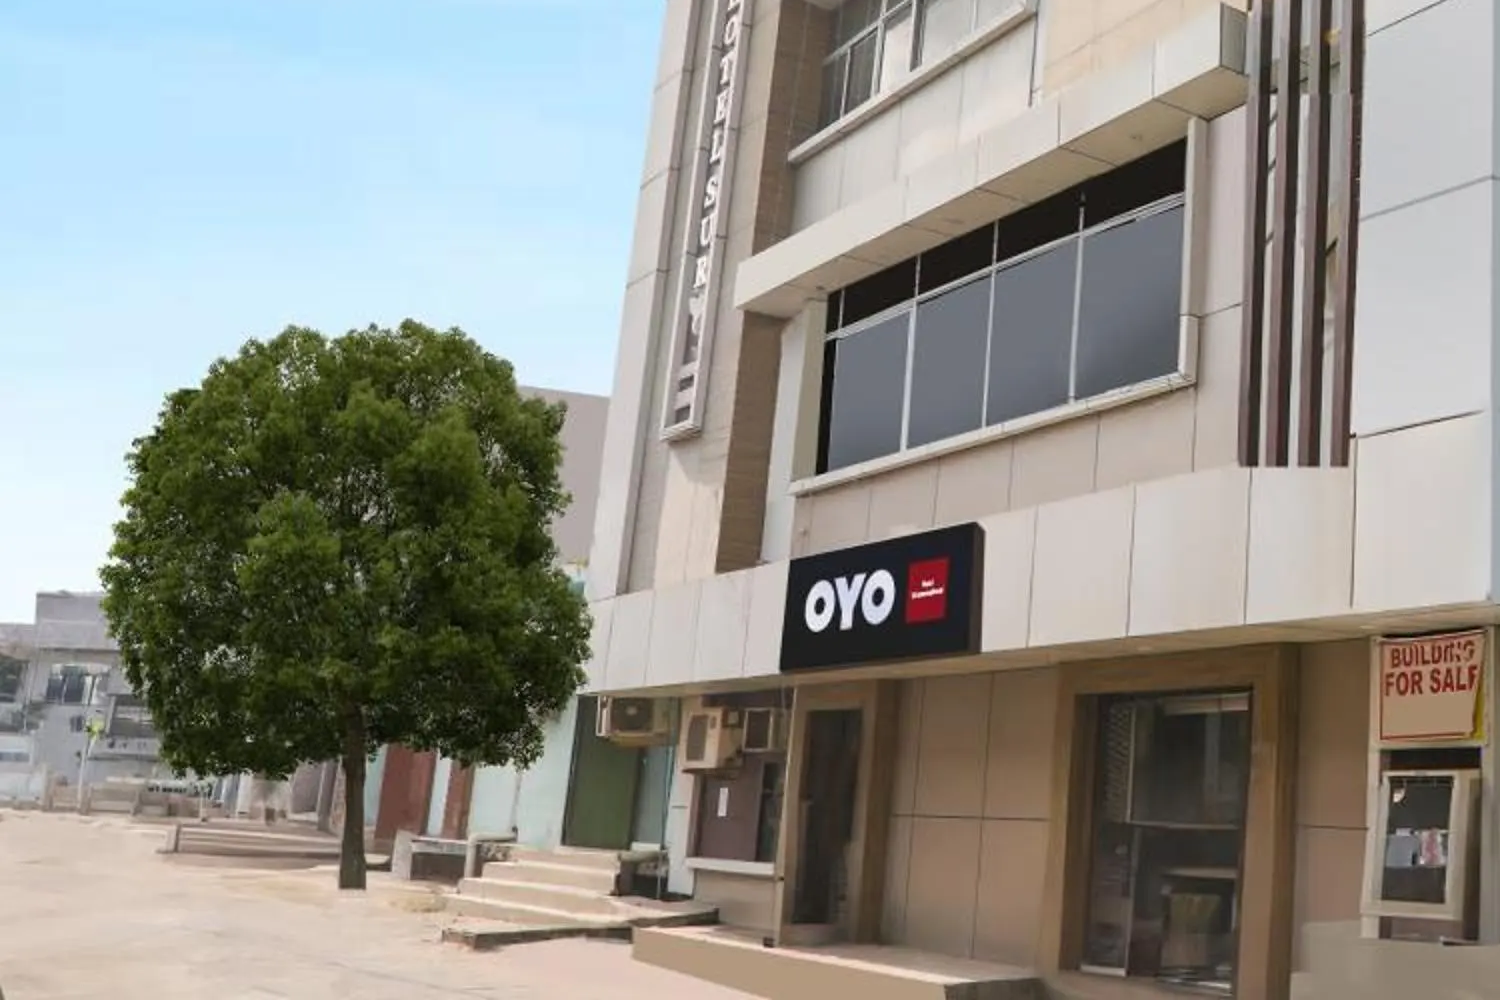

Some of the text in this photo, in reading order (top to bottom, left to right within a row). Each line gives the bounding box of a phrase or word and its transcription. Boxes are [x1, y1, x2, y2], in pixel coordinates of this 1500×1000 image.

[805, 569, 895, 632] OYO
[1391, 640, 1475, 668] BUILDING
[1385, 671, 1423, 696] FOR
